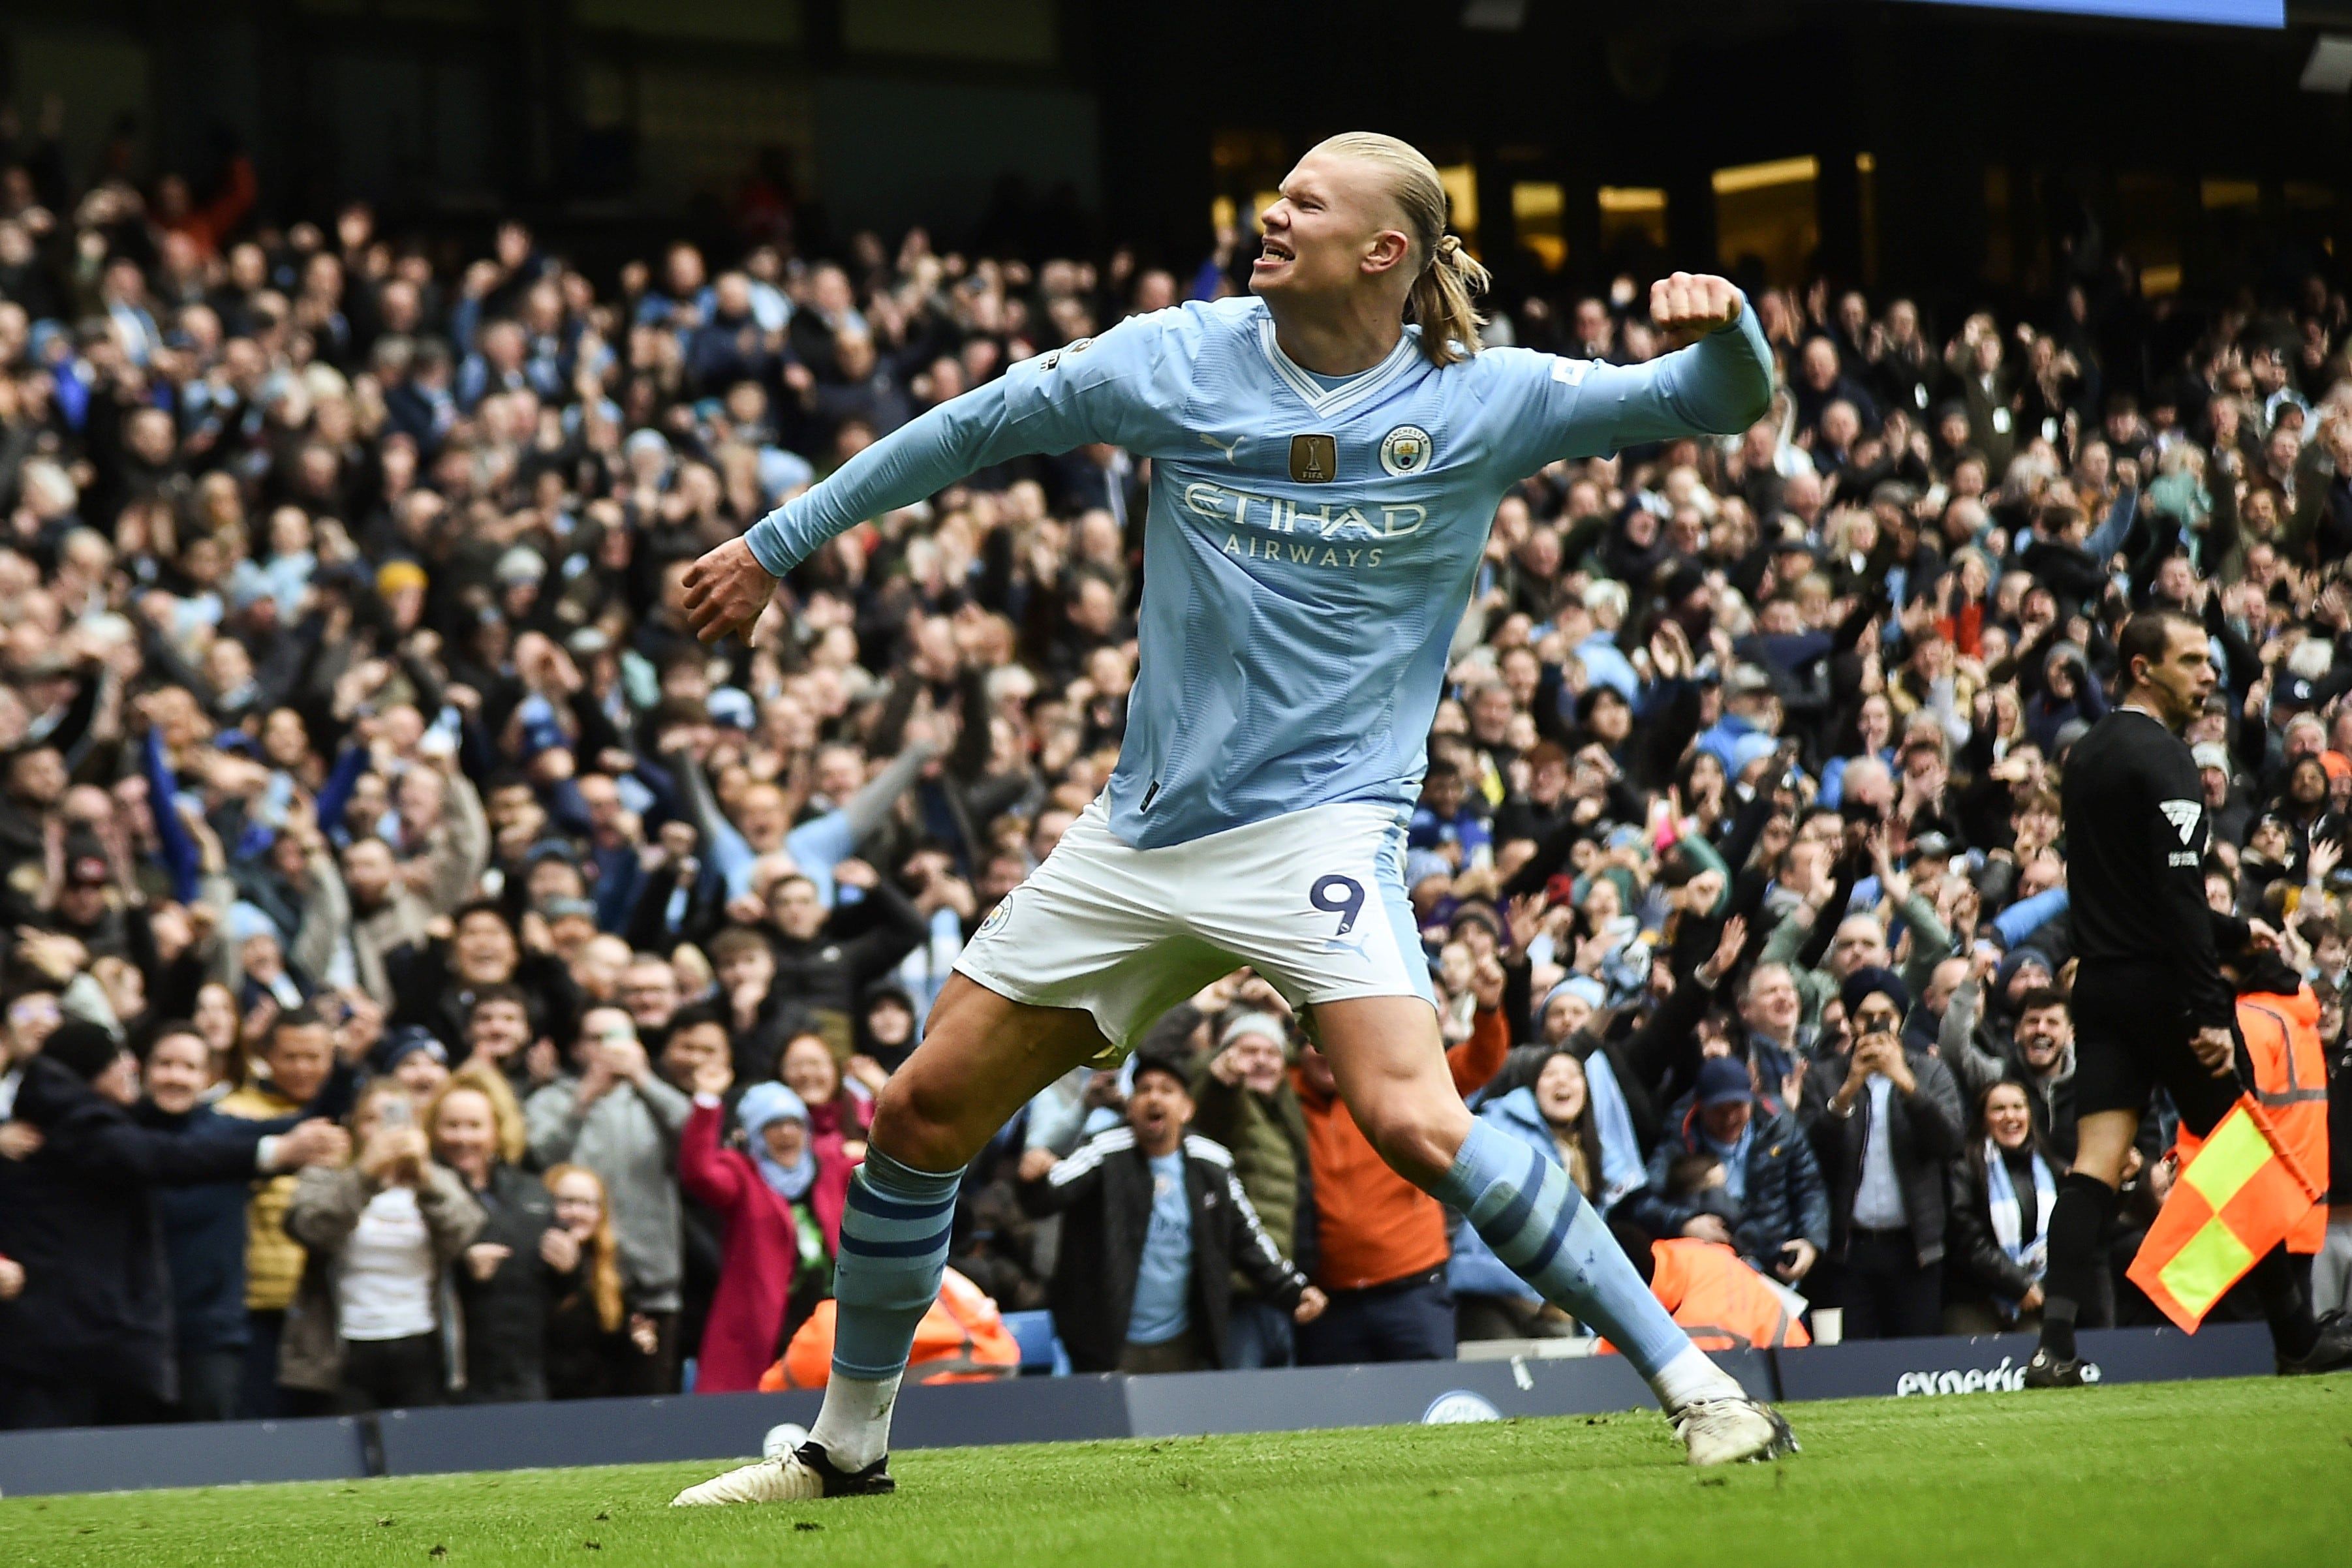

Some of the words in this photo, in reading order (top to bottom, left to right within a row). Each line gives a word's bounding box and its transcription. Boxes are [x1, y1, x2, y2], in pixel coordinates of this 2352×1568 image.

[1384, 428, 1428, 448] MANCHESTER
[1303, 471, 1323, 480] FIFA
[1184, 482, 1427, 537] ETIHAD
[1223, 532, 1383, 568] AIRWAYS
[1310, 874, 1365, 936] 9
